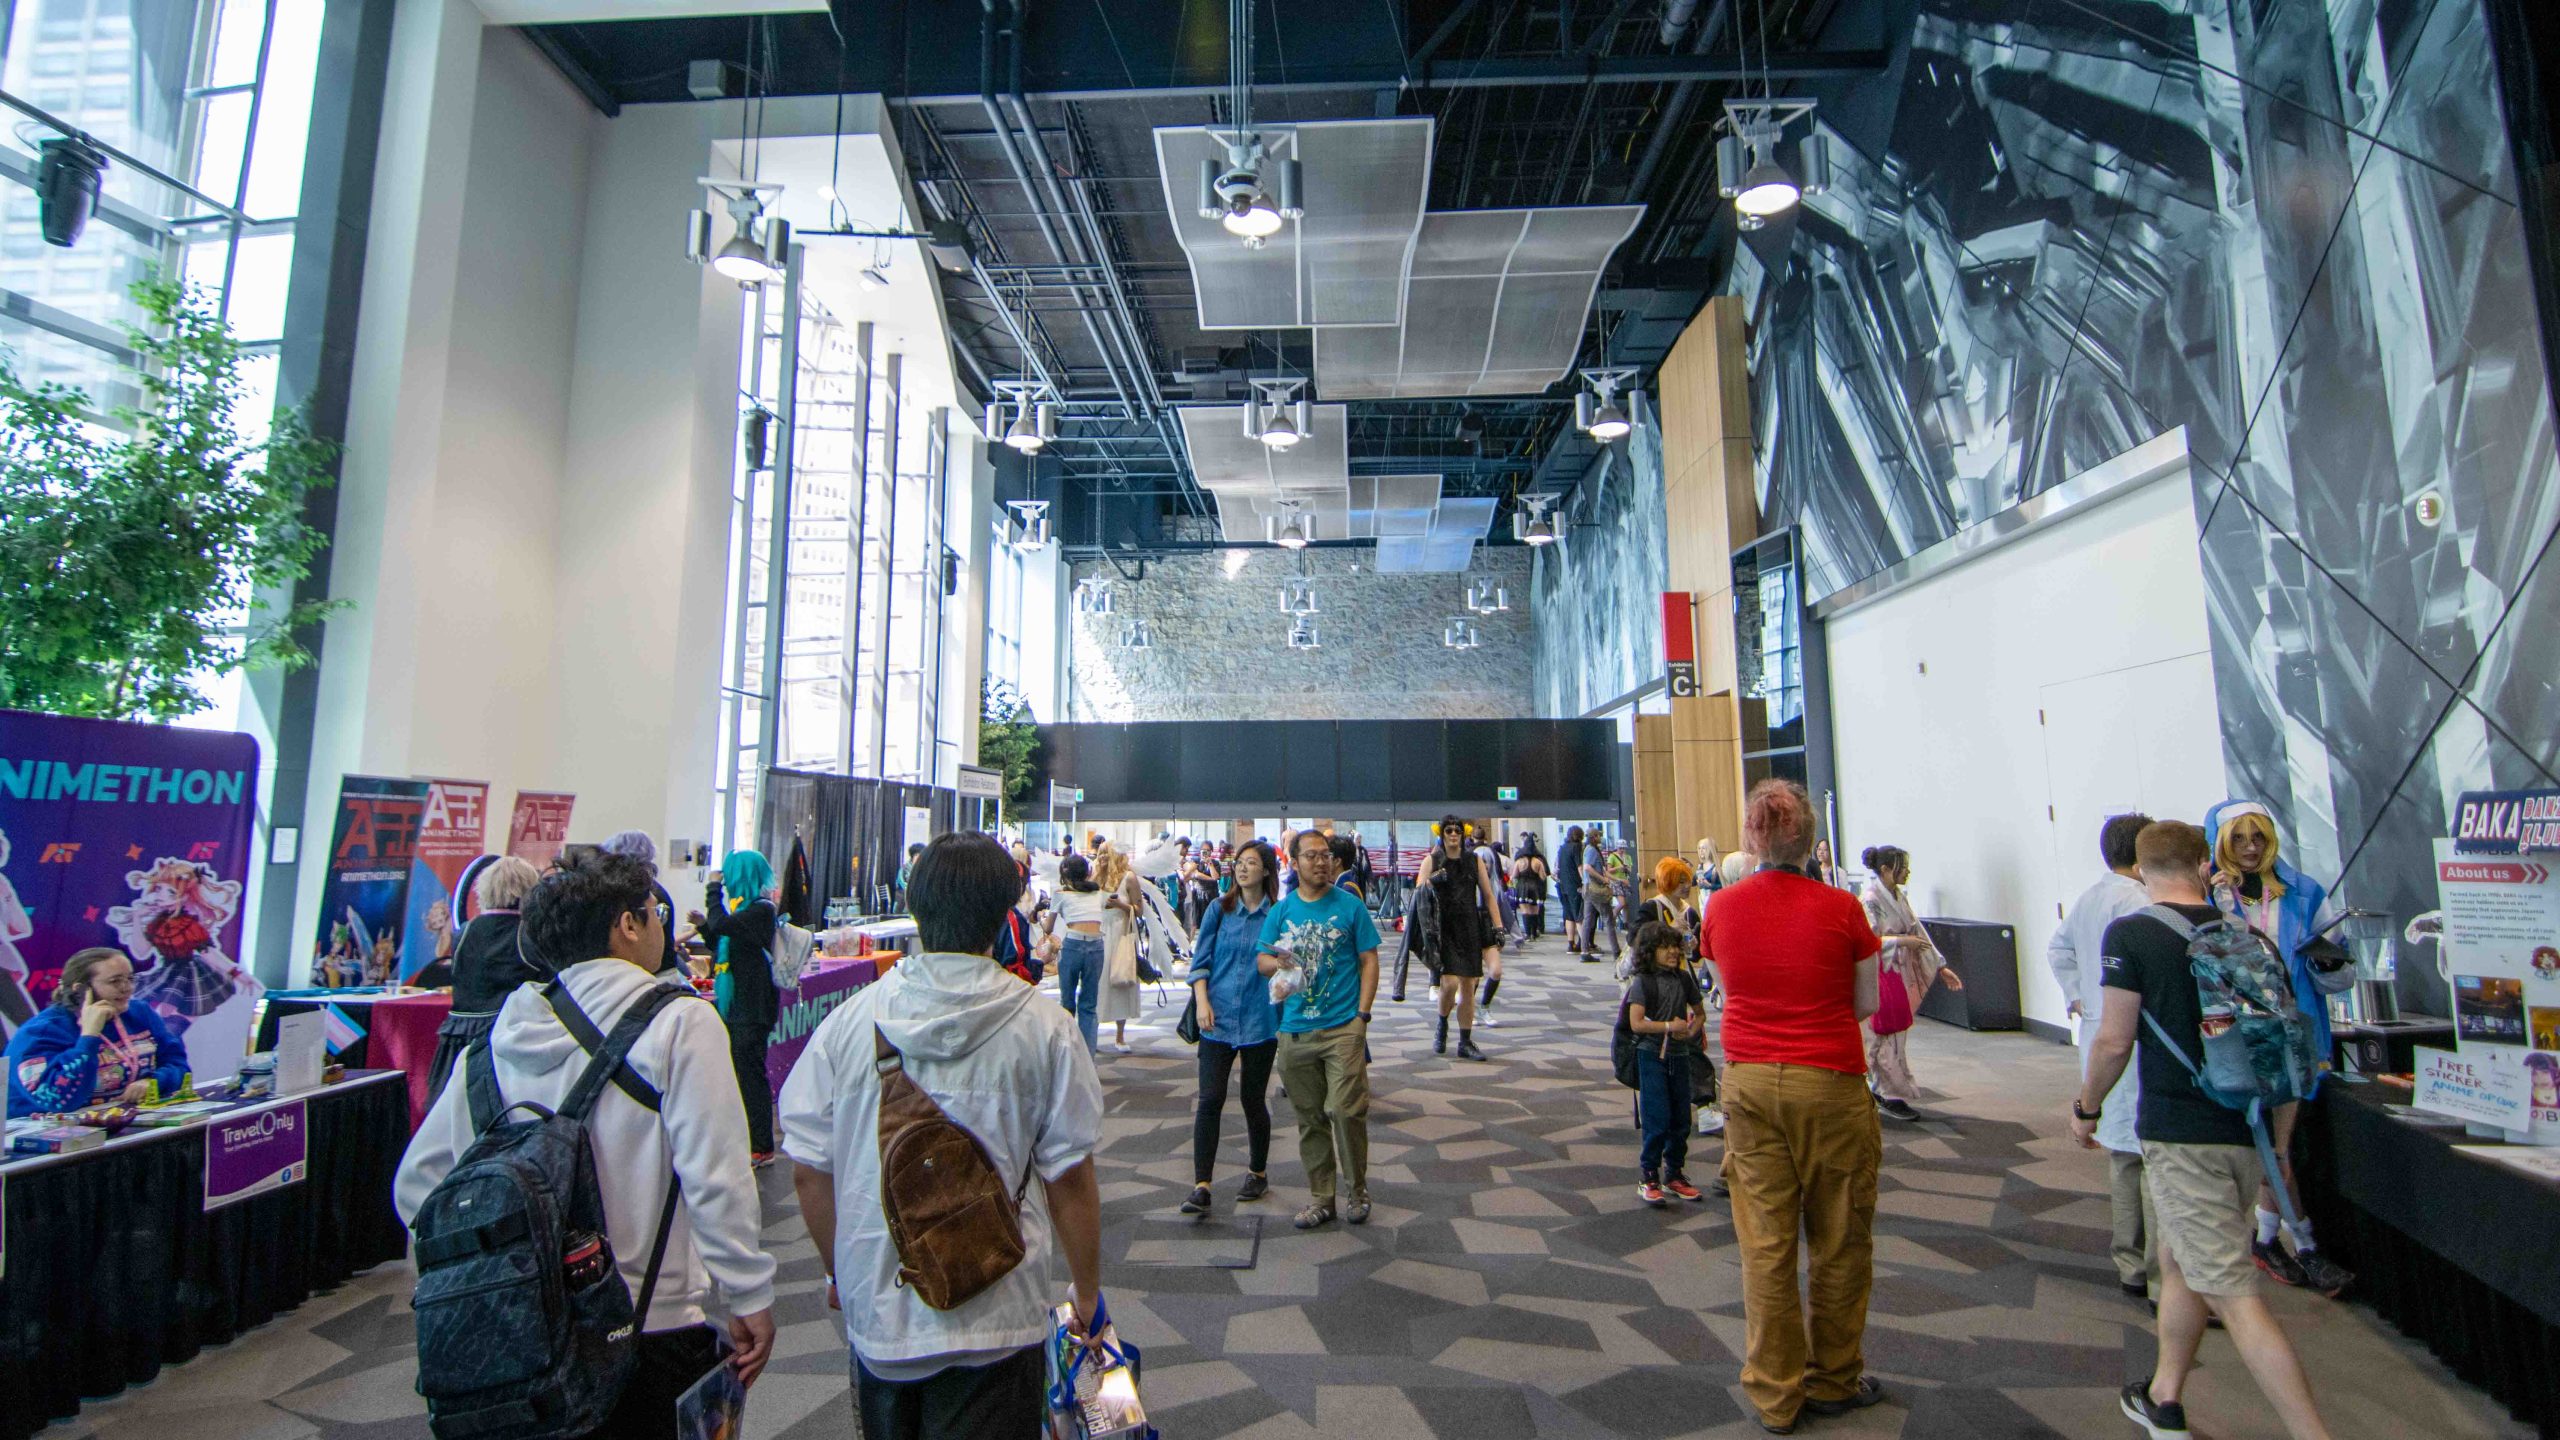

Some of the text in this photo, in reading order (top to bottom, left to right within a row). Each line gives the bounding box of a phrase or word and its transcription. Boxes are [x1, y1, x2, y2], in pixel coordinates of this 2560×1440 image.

[1673, 675, 1690, 696] C
[2459, 801, 2520, 839] BAKA
[420, 829, 480, 838] ANIMETHON
[2446, 866, 2510, 879] About us
[2437, 1057, 2475, 1076] FREE
[2425, 1067, 2486, 1089] STICKER
[2432, 1080, 2474, 1097] ANIME
[221, 1111, 294, 1144] TravelOnly
[1082, 1399, 1107, 1435] ECLIPSE
